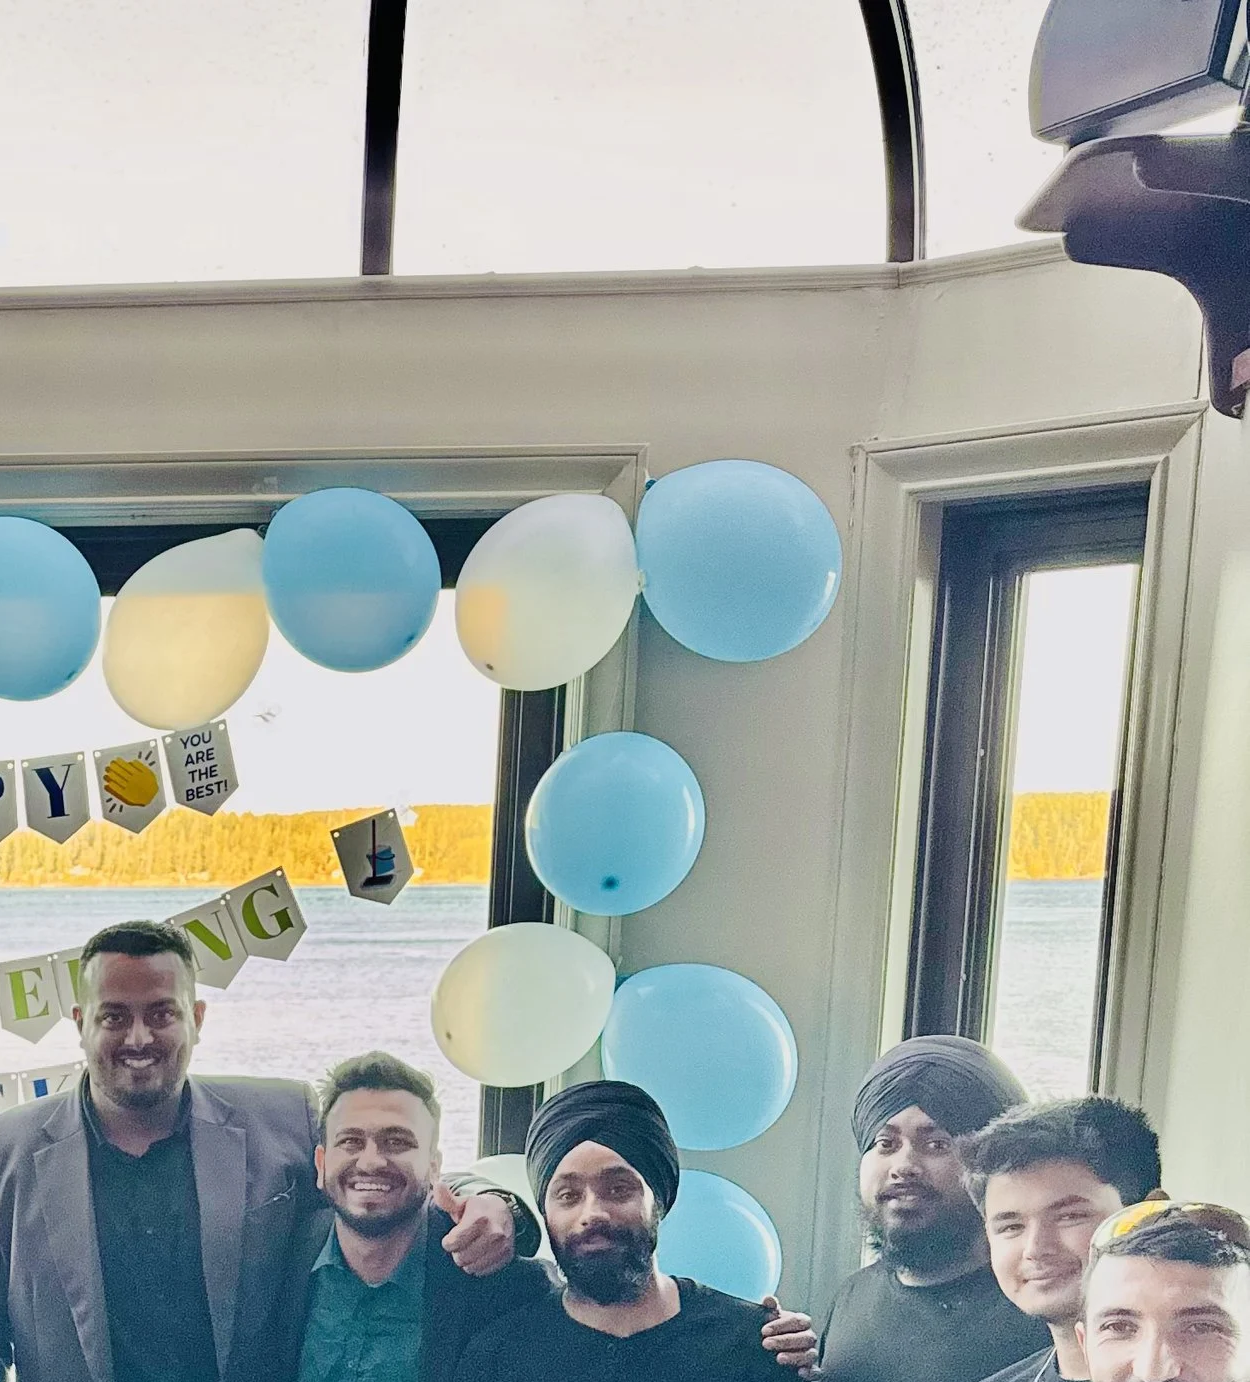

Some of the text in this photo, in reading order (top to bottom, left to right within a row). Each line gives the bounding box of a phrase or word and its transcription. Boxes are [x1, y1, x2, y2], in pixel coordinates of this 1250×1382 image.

[180, 730, 212, 749] YOU
[185, 747, 215, 767] ARE
[188, 764, 219, 783] THE
[186, 779, 228, 801] BEST!
